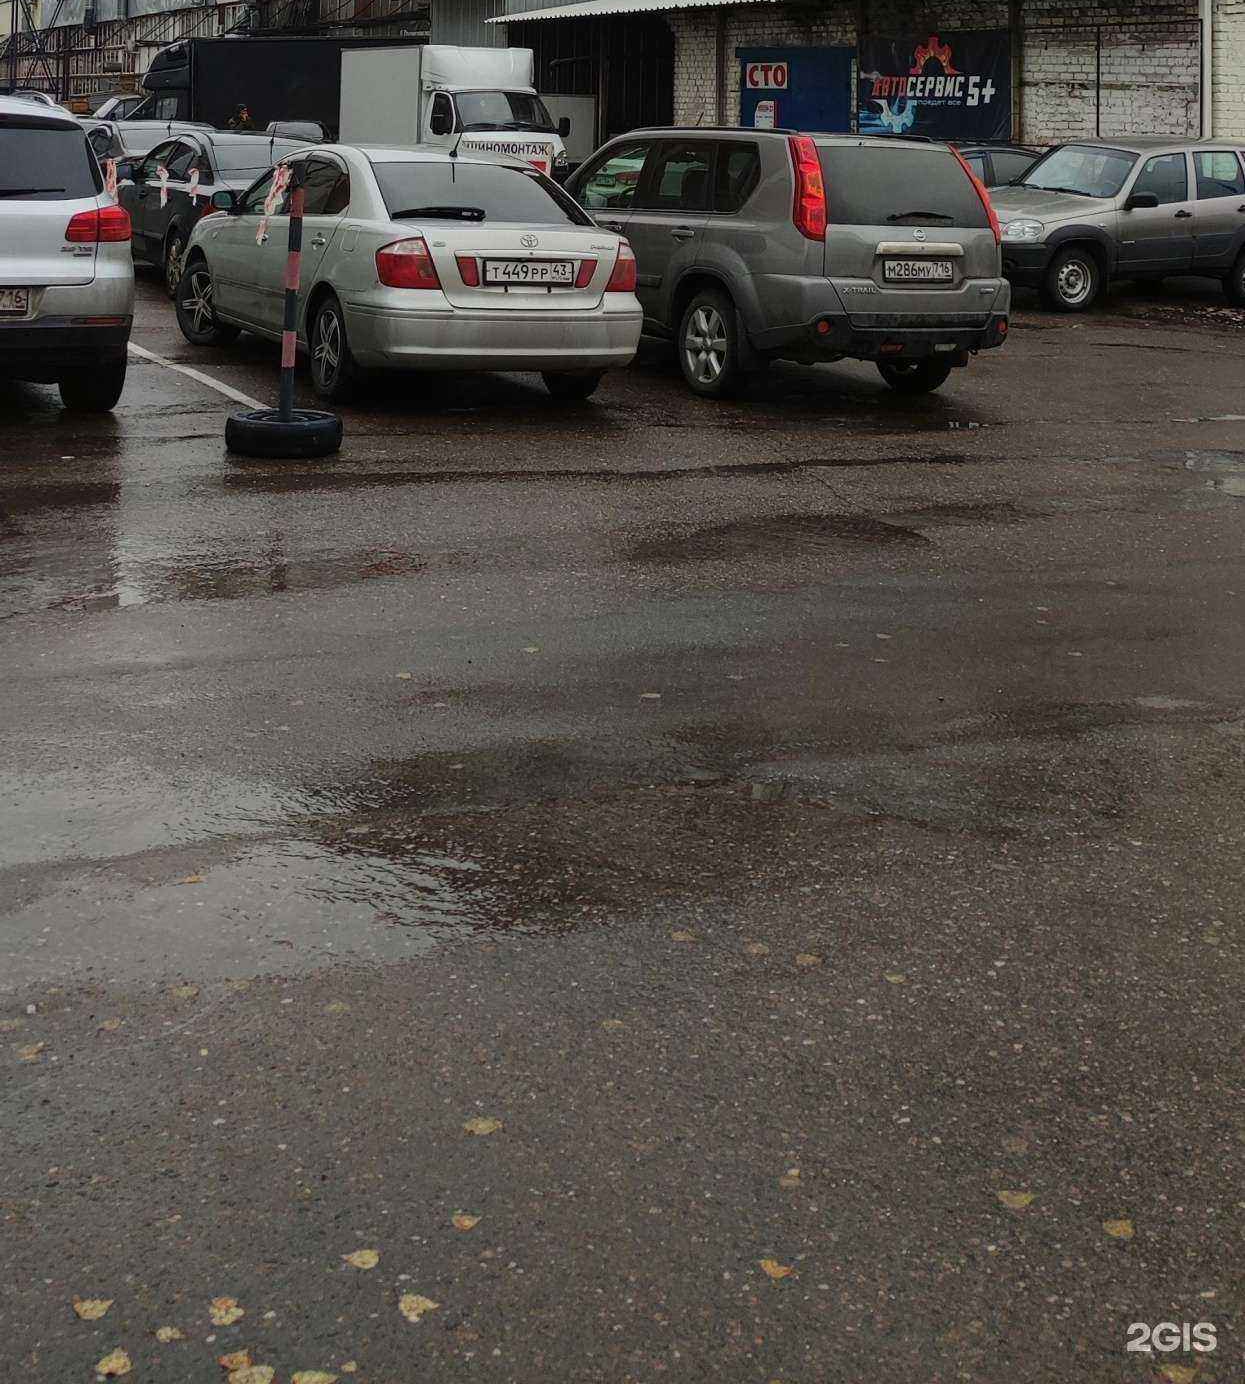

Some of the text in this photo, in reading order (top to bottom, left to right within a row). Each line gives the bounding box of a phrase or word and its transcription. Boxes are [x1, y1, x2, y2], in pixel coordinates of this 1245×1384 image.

[748, 65, 786, 87] СТО
[871, 76, 996, 106] АВТОСЕРВИС 5+
[466, 142, 549, 156] ШИНОМОНТАЖ
